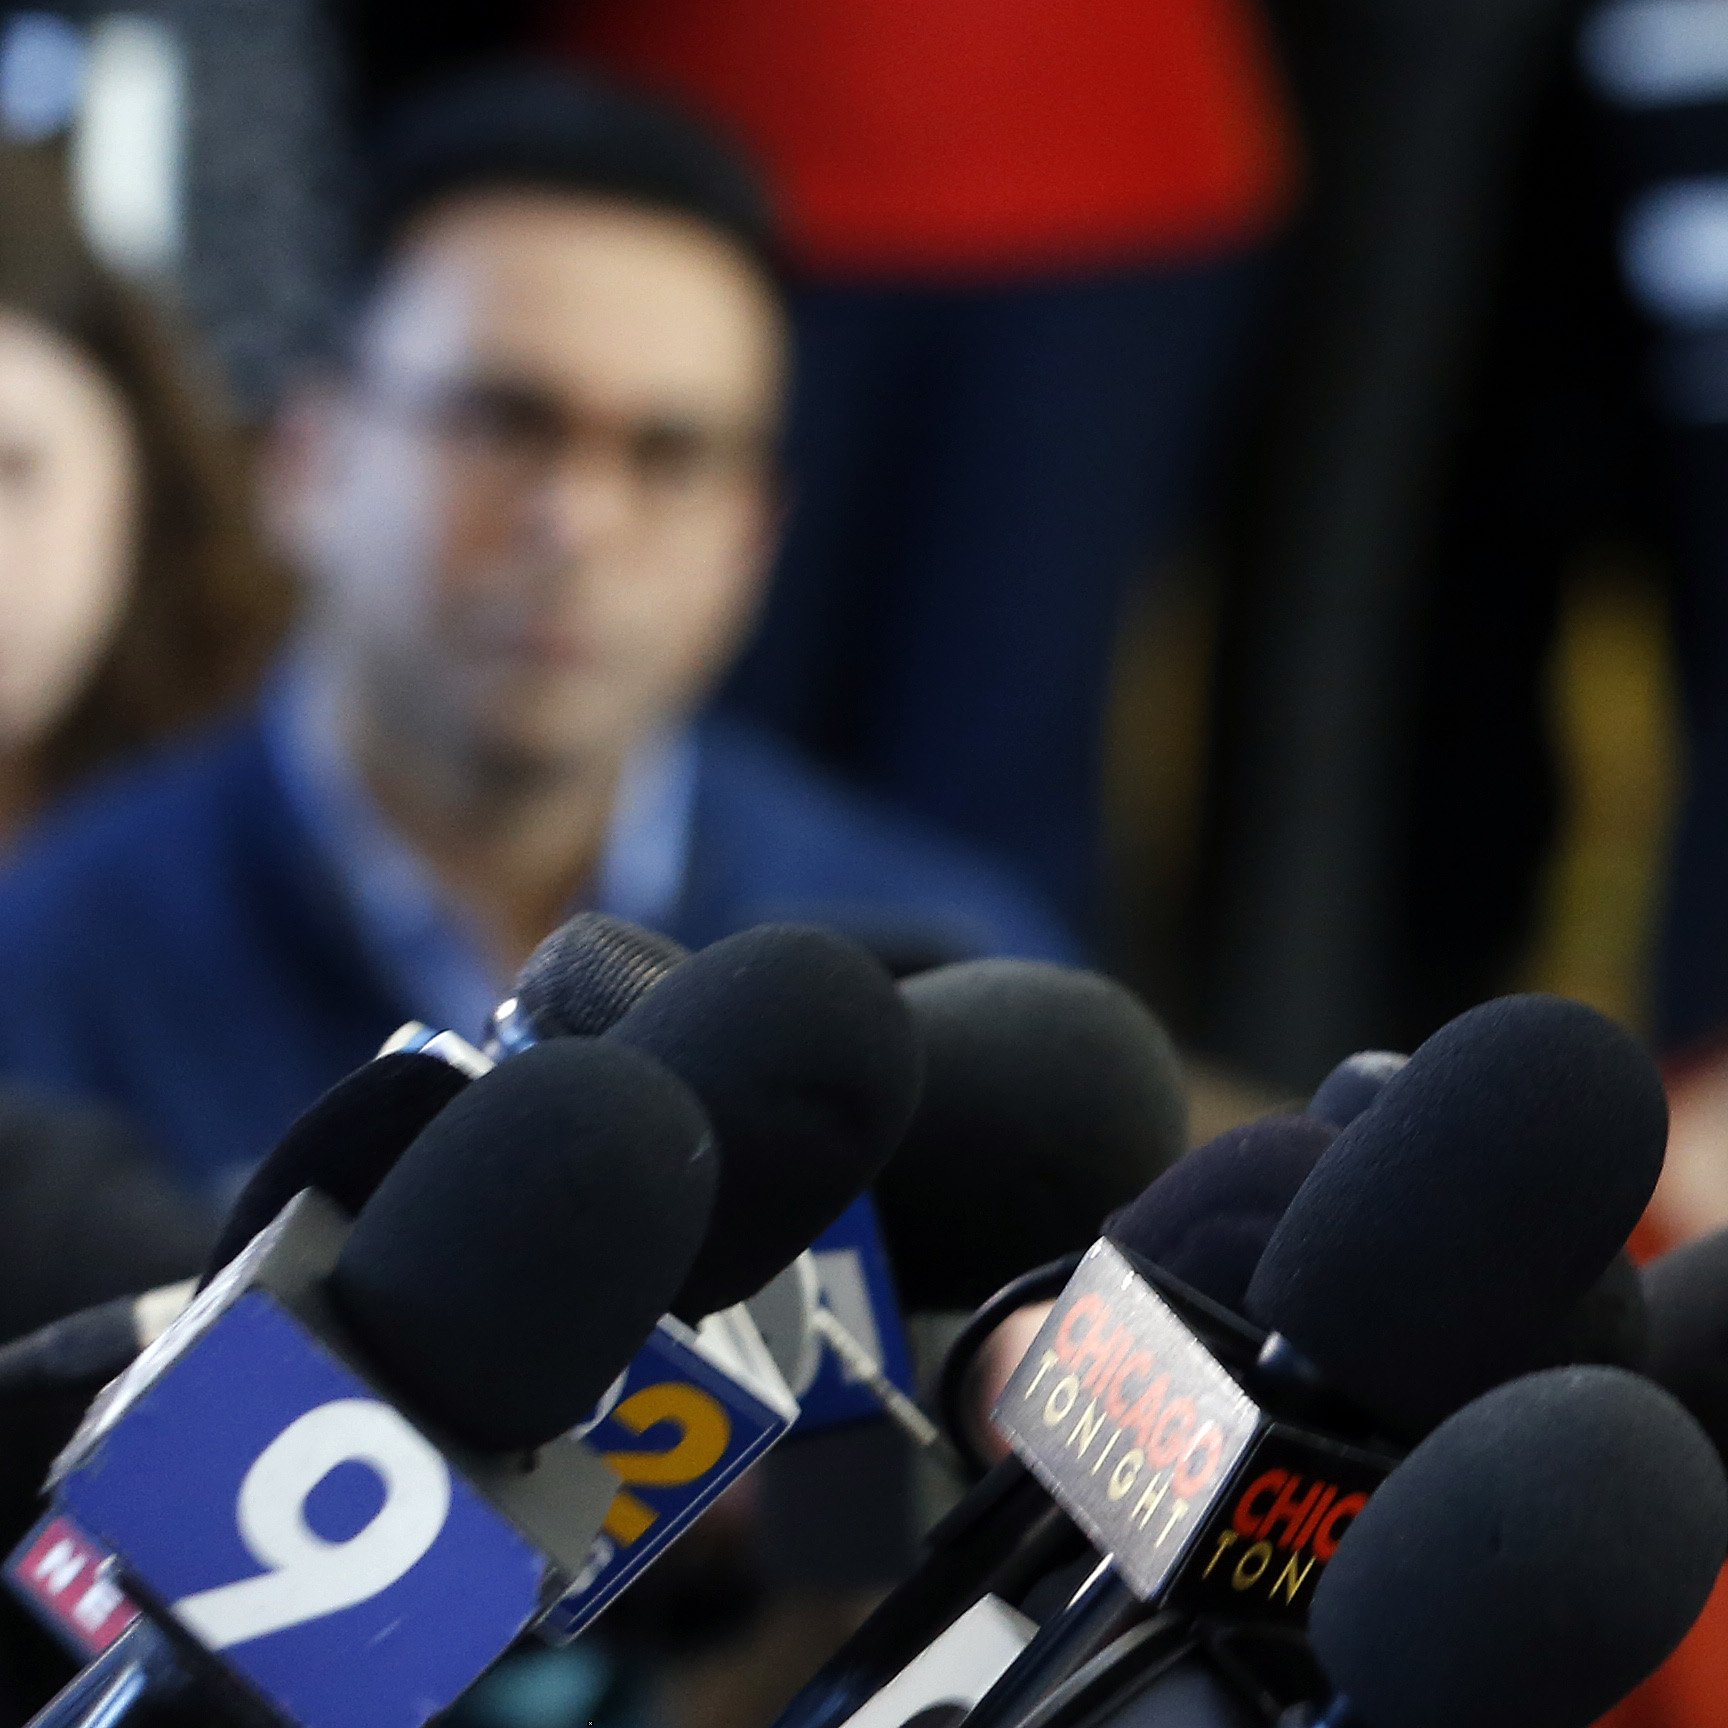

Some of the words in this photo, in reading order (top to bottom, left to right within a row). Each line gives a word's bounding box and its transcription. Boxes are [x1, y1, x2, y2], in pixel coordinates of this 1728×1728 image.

[604, 1382, 732, 1549] 2
[1023, 1348, 1189, 1549] TONIGHT
[1053, 1293, 1224, 1499] CHICAGO
[171, 1397, 452, 1651] 9
